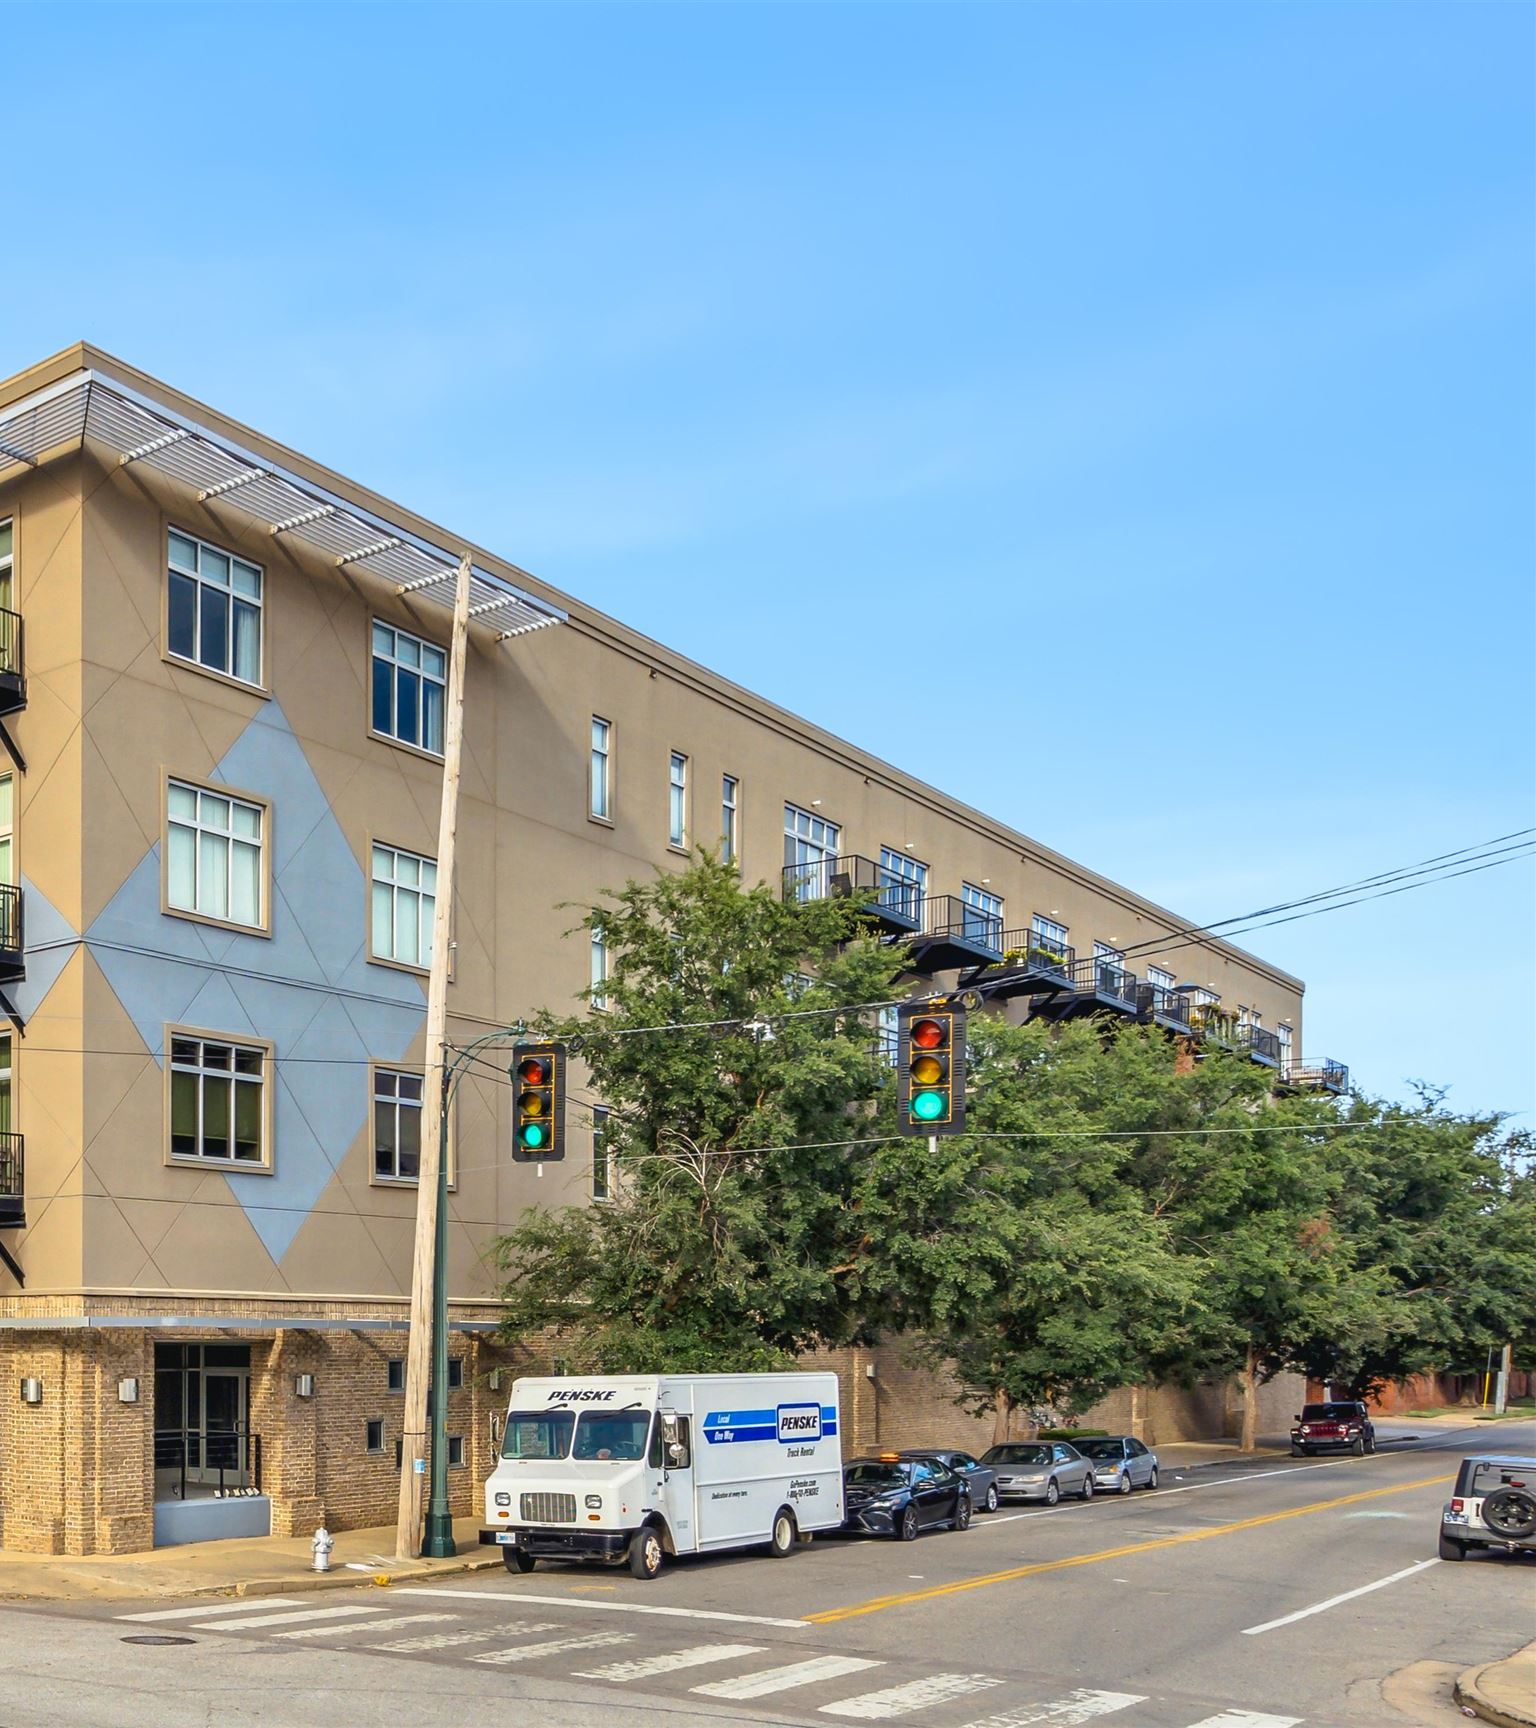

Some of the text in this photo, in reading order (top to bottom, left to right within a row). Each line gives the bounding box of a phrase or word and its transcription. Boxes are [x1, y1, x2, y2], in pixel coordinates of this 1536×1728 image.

[548, 1391, 616, 1401] PENSKE
[717, 1414, 730, 1424] Local
[781, 1416, 818, 1430] PENSKE
[714, 1430, 734, 1442] One Way
[787, 1446, 815, 1458] Truck Rental
